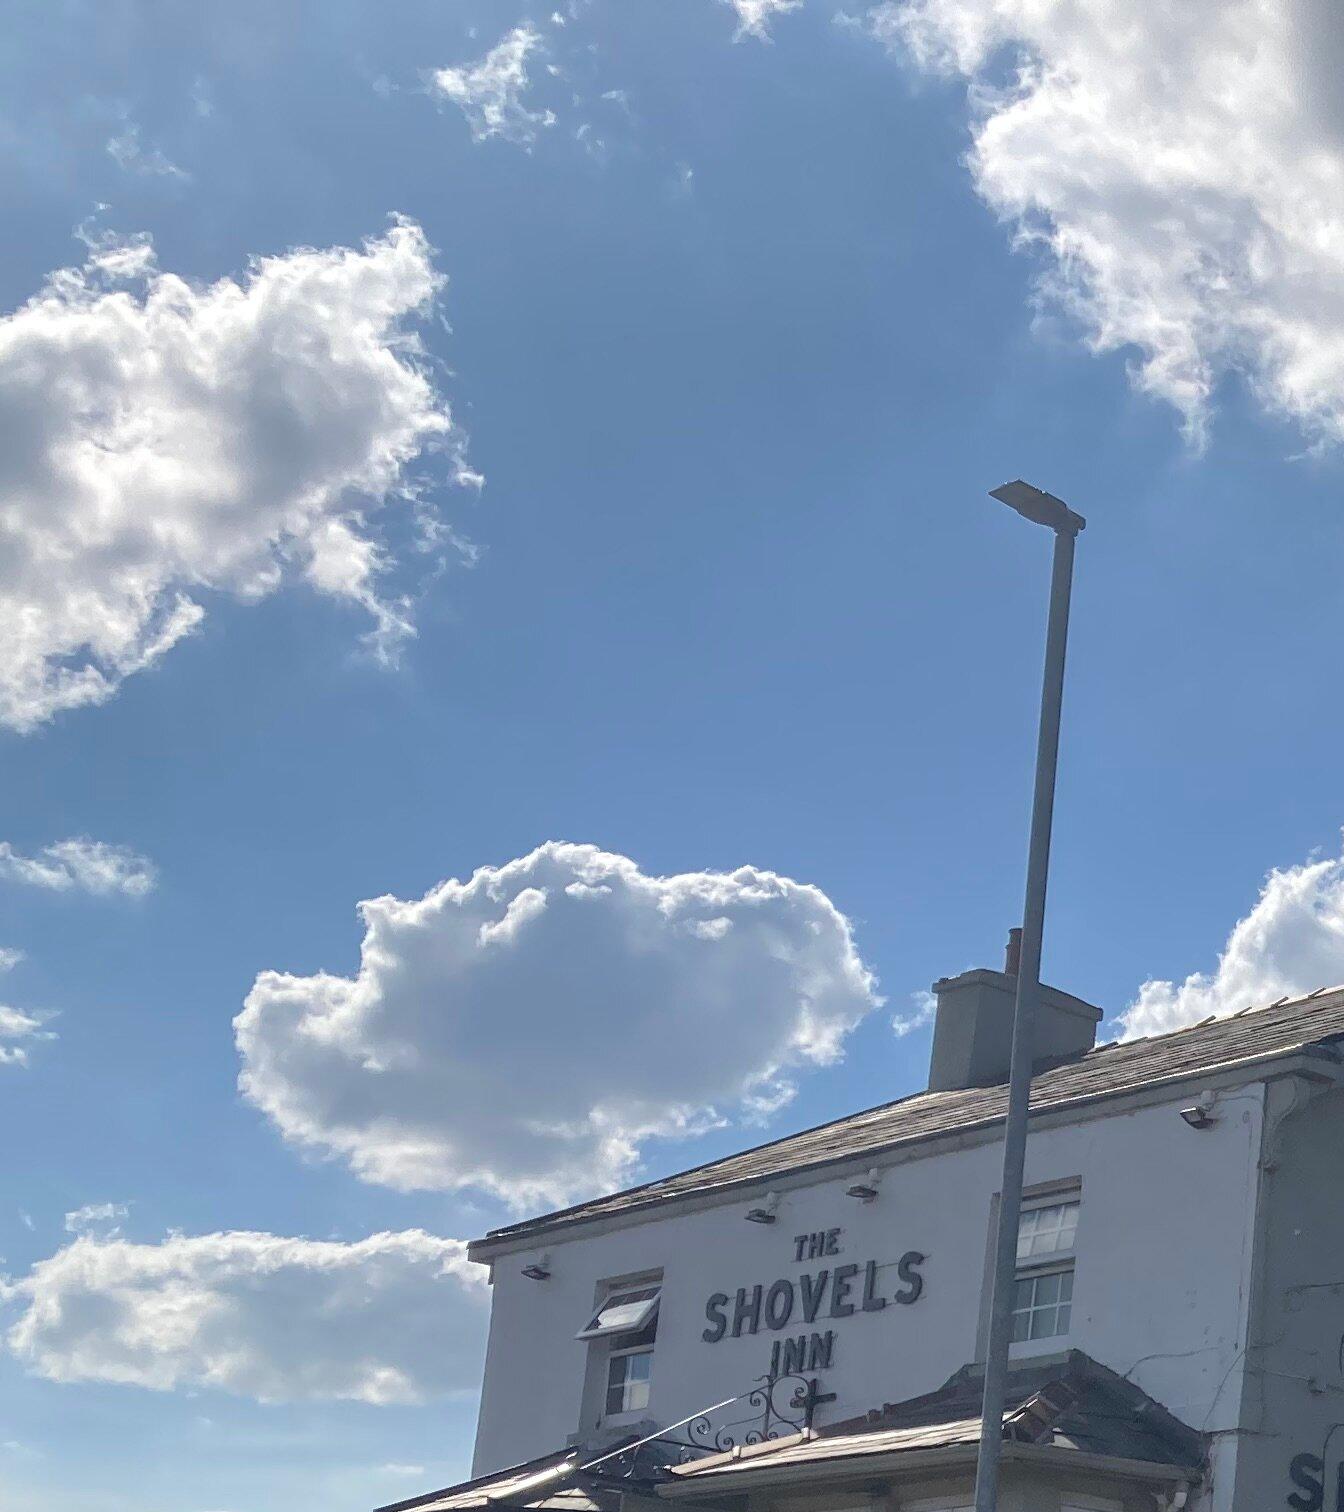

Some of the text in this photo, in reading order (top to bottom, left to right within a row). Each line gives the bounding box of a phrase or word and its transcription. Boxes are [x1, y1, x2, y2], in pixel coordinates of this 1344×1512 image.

[793, 1227, 841, 1262] THE
[702, 1250, 925, 1343] SHOVELS
[769, 1330, 834, 1378] INN
